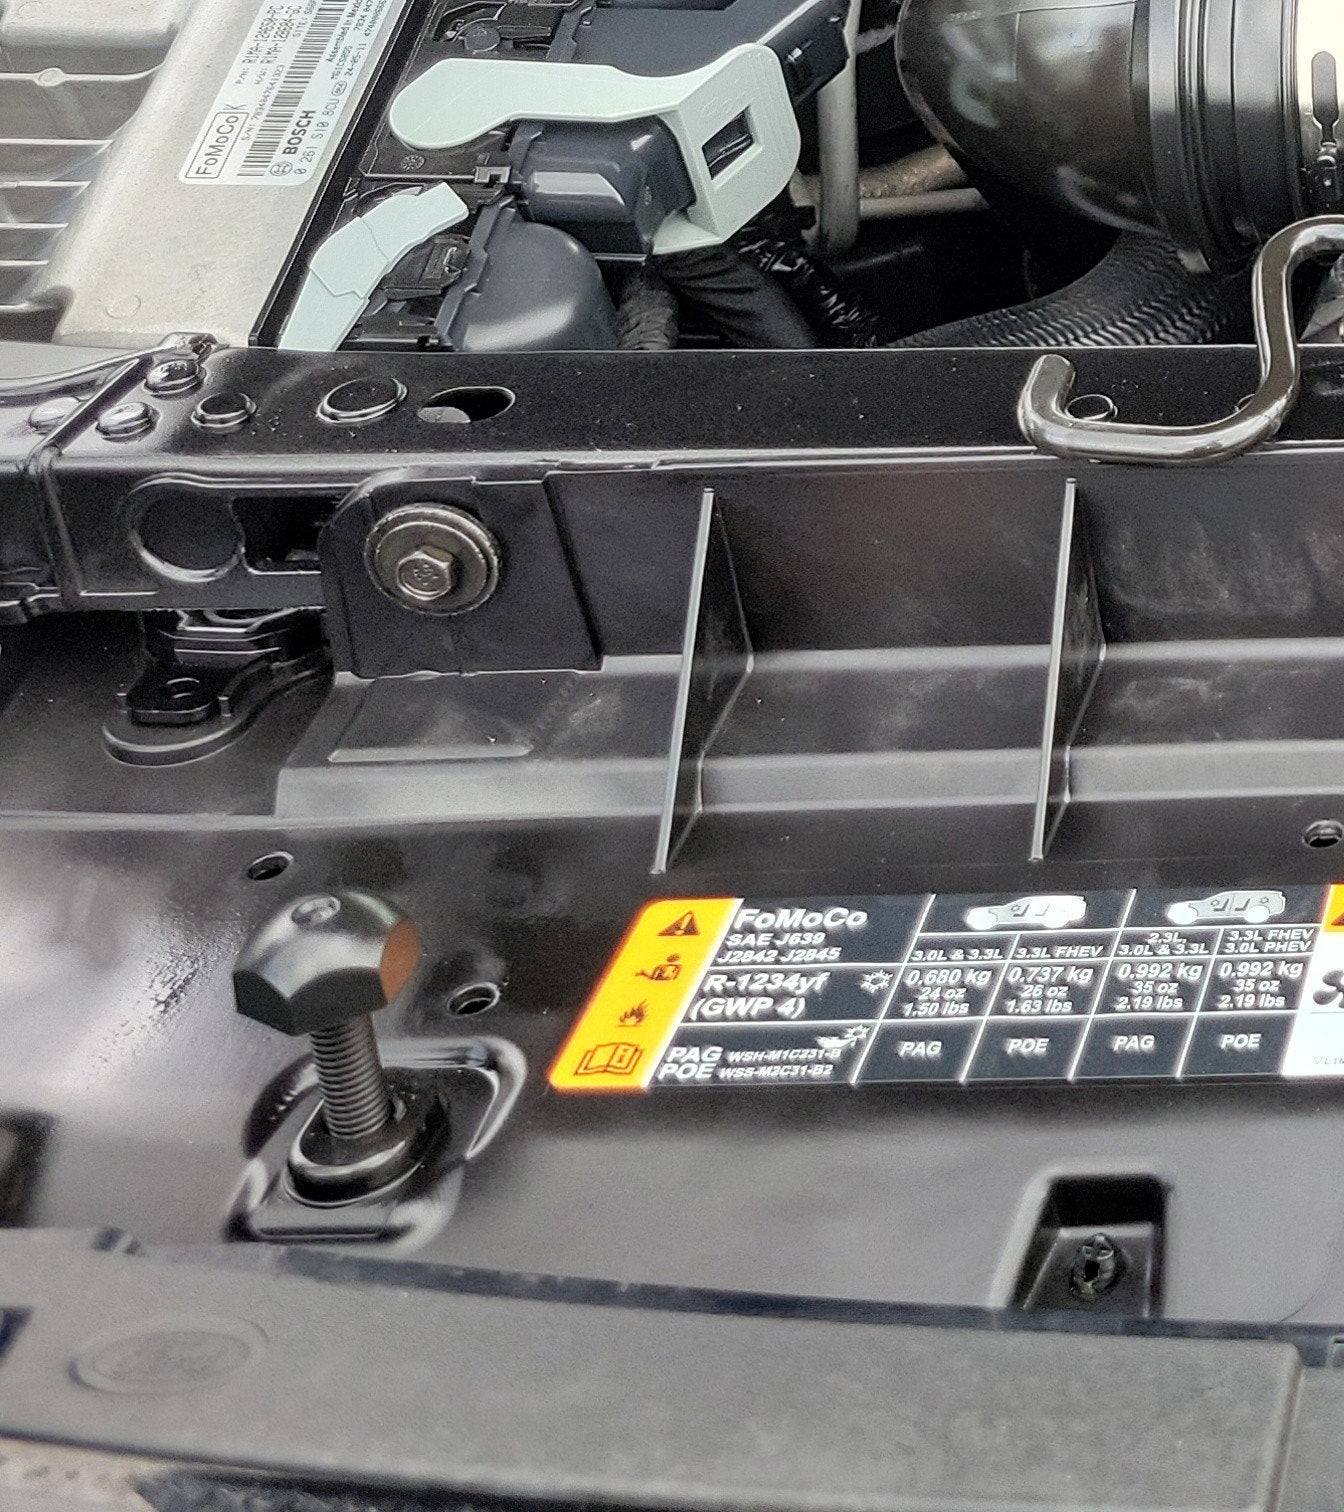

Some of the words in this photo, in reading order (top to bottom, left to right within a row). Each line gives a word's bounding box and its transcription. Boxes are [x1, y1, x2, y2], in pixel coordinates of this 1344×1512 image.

[326, 26, 349, 62] Assembled
[282, 110, 316, 155] BOSCH
[196, 115, 239, 176] FoMoCo
[300, 146, 318, 163] 261
[733, 907, 868, 929] FoMoCo
[726, 933, 773, 947] SAE
[775, 932, 827, 946] J639
[1229, 929, 1263, 941] 3.3L
[1265, 928, 1315, 940] FHEV
[911, 947, 947, 960] 3.0L
[949, 948, 964, 960] &
[966, 946, 1003, 959] 3.3L
[1015, 946, 1051, 958] 3.3L
[1055, 945, 1104, 958] FHEV
[1118, 944, 1154, 955] 3.0L
[1157, 943, 1170, 955] &
[1172, 942, 1210, 954] 3.3L
[1224, 941, 1259, 953] 3.0L
[1264, 940, 1312, 952] PHEV
[718, 949, 778, 963] J2842
[779, 947, 842, 962] J2845
[905, 969, 962, 986] 0.680
[964, 968, 992, 986] kg
[1007, 967, 1064, 984] 0.737
[1066, 966, 1094, 984] kg
[1117, 963, 1172, 979] 0.992
[1175, 962, 1204, 980] kg
[1218, 961, 1274, 978] 0.992
[1277, 960, 1304, 979] kg
[702, 971, 830, 994] R-1234yf
[1132, 980, 1154, 993] 35
[1157, 981, 1179, 993] oz
[1233, 979, 1255, 992] 35
[1258, 979, 1281, 992] oz
[917, 987, 942, 1000] 24
[944, 988, 967, 999] oz
[1020, 985, 1043, 998] 26
[1046, 986, 1069, 997] oz
[690, 997, 774, 1020] (GWP
[777, 997, 806, 1019] 4)
[903, 1002, 939, 1016] 1.50
[942, 1001, 970, 1015] lbs
[1005, 999, 1041, 1013] 1.63
[1045, 999, 1072, 1013] lbs
[1114, 996, 1153, 1010] 2.19
[1156, 995, 1184, 1009] lbs
[1217, 995, 1255, 1008] 2.19
[1258, 993, 1286, 1007] lbs
[899, 1040, 942, 1057] PAG
[1006, 1037, 1050, 1054] POE
[1113, 1034, 1155, 1051] PAG
[1220, 1033, 1262, 1049] POE
[666, 1046, 723, 1063] PAG
[657, 1062, 716, 1079] POE
